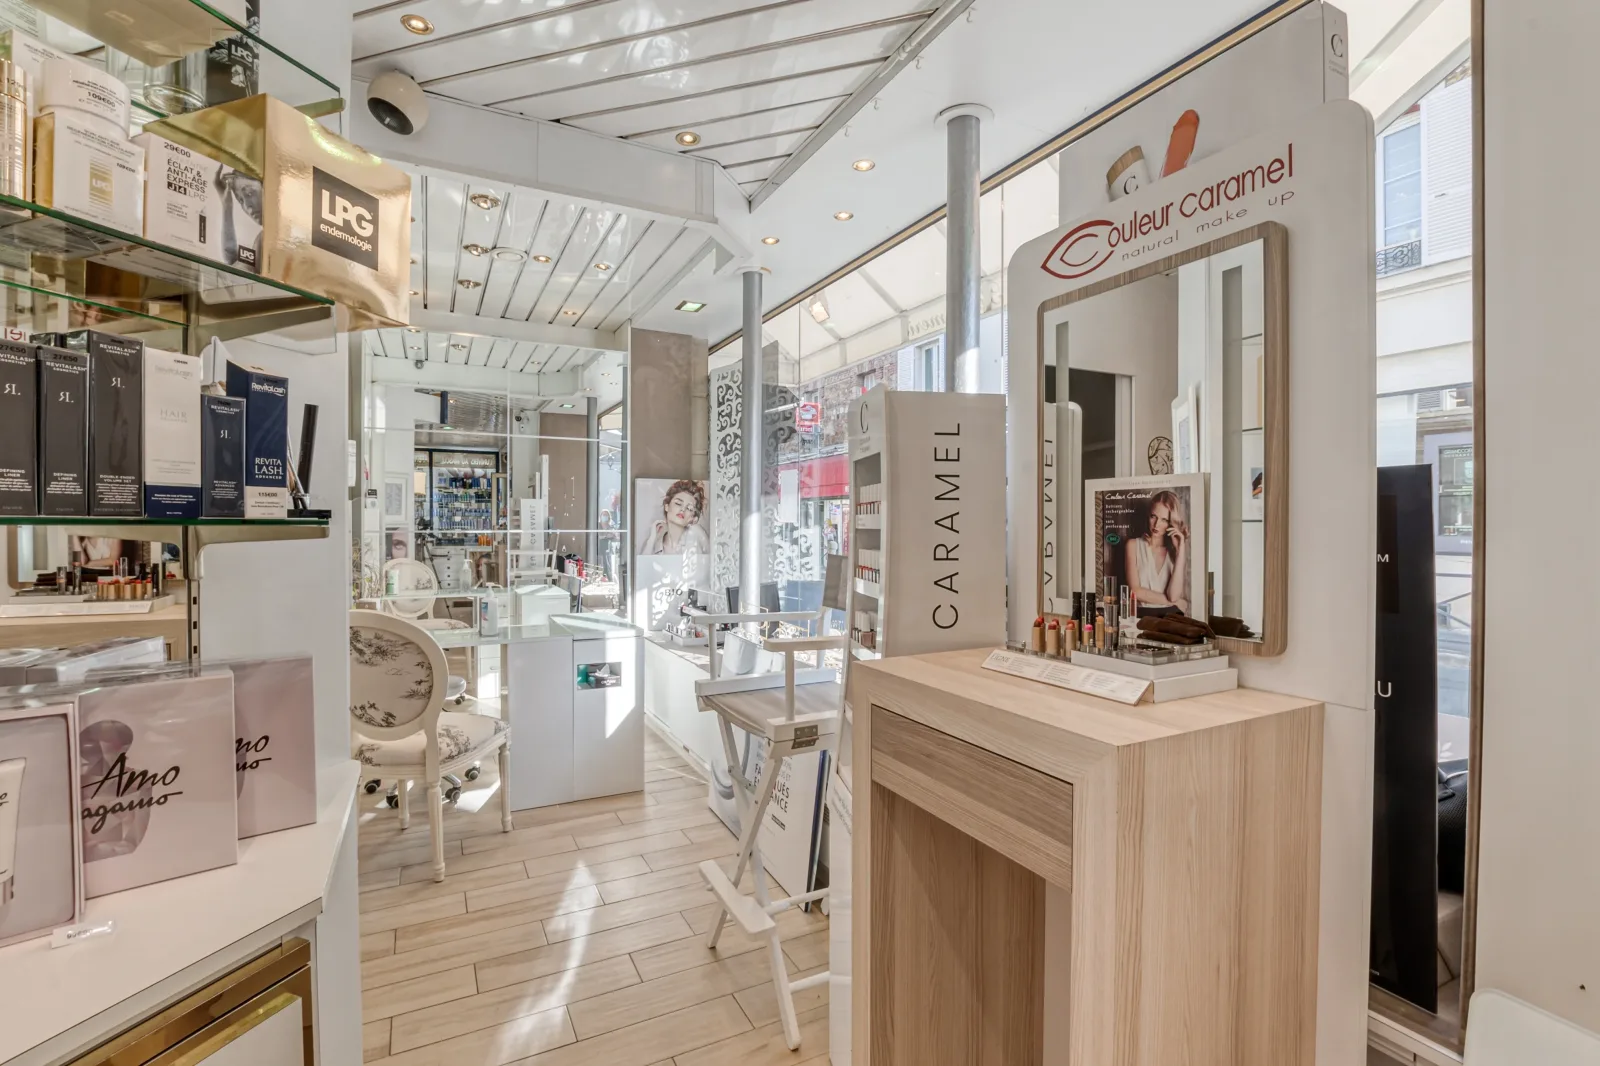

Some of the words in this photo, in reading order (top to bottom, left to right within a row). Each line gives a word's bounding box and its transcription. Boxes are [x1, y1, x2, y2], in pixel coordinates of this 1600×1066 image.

[231, 44, 253, 63] LPG
[164, 141, 191, 158] 29€00
[167, 156, 194, 175] ÉCLAT
[196, 170, 203, 178] &
[167, 173, 206, 194] EXPRESS
[1123, 174, 1139, 195] C
[322, 188, 374, 238] LPG
[1121, 229, 1180, 262] natural
[1195, 206, 1249, 235] make
[1267, 189, 1295, 207] up
[320, 223, 372, 252] endermologie
[240, 248, 254, 260] LPG
[53, 353, 78, 363] 27€50
[160, 408, 187, 419] HAIR
[860, 400, 869, 434] C
[255, 457, 282, 466] REVITA
[255, 465, 284, 475] LASH
[932, 422, 961, 630] CARAMEL
[1377, 680, 1392, 698] U
[81, 751, 180, 800] Amo
